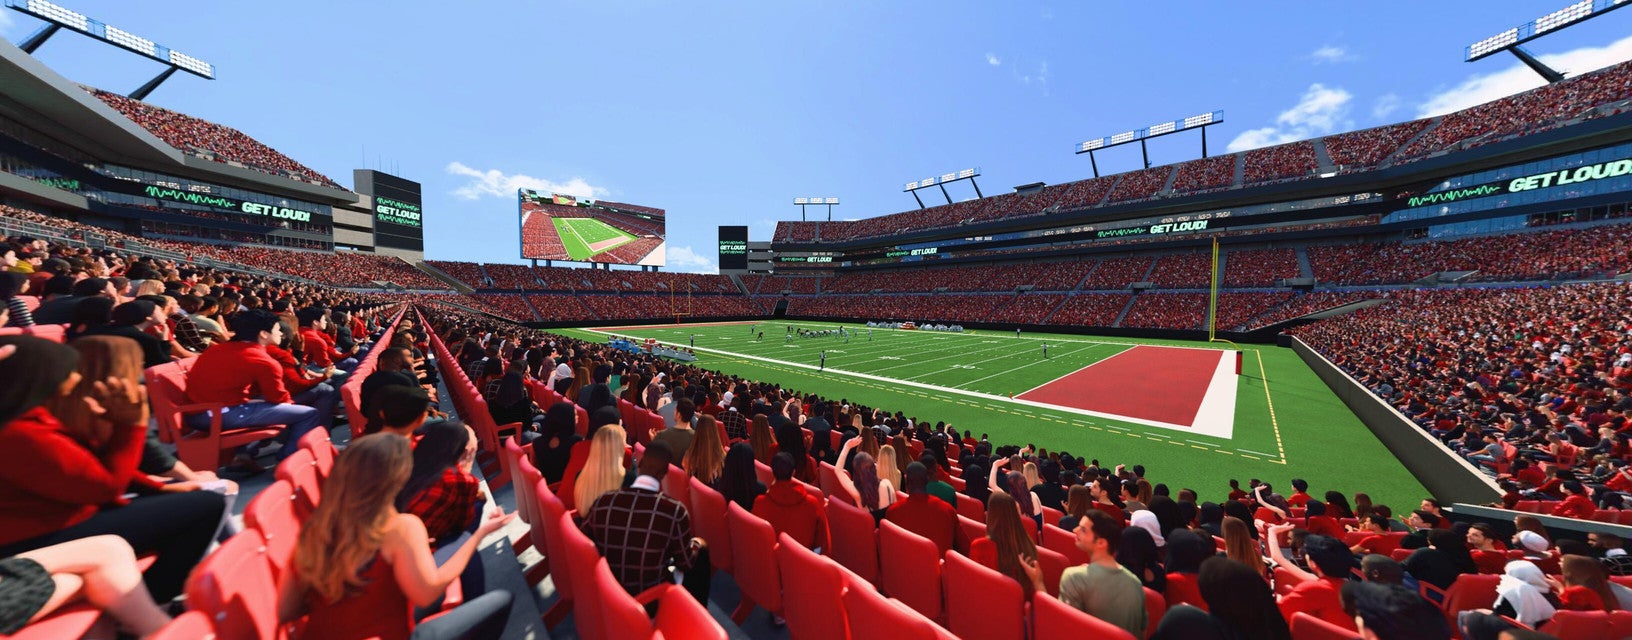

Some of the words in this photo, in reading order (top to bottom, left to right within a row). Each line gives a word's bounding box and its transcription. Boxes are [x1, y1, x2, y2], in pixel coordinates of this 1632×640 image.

[1508, 172, 1558, 192] GET
[242, 202, 271, 215] GET
[272, 207, 310, 222] LOUD!
[377, 205, 395, 215] GET
[396, 209, 420, 220] LOUD!
[1150, 224, 1172, 234] GET
[1173, 220, 1208, 231] LOUD!
